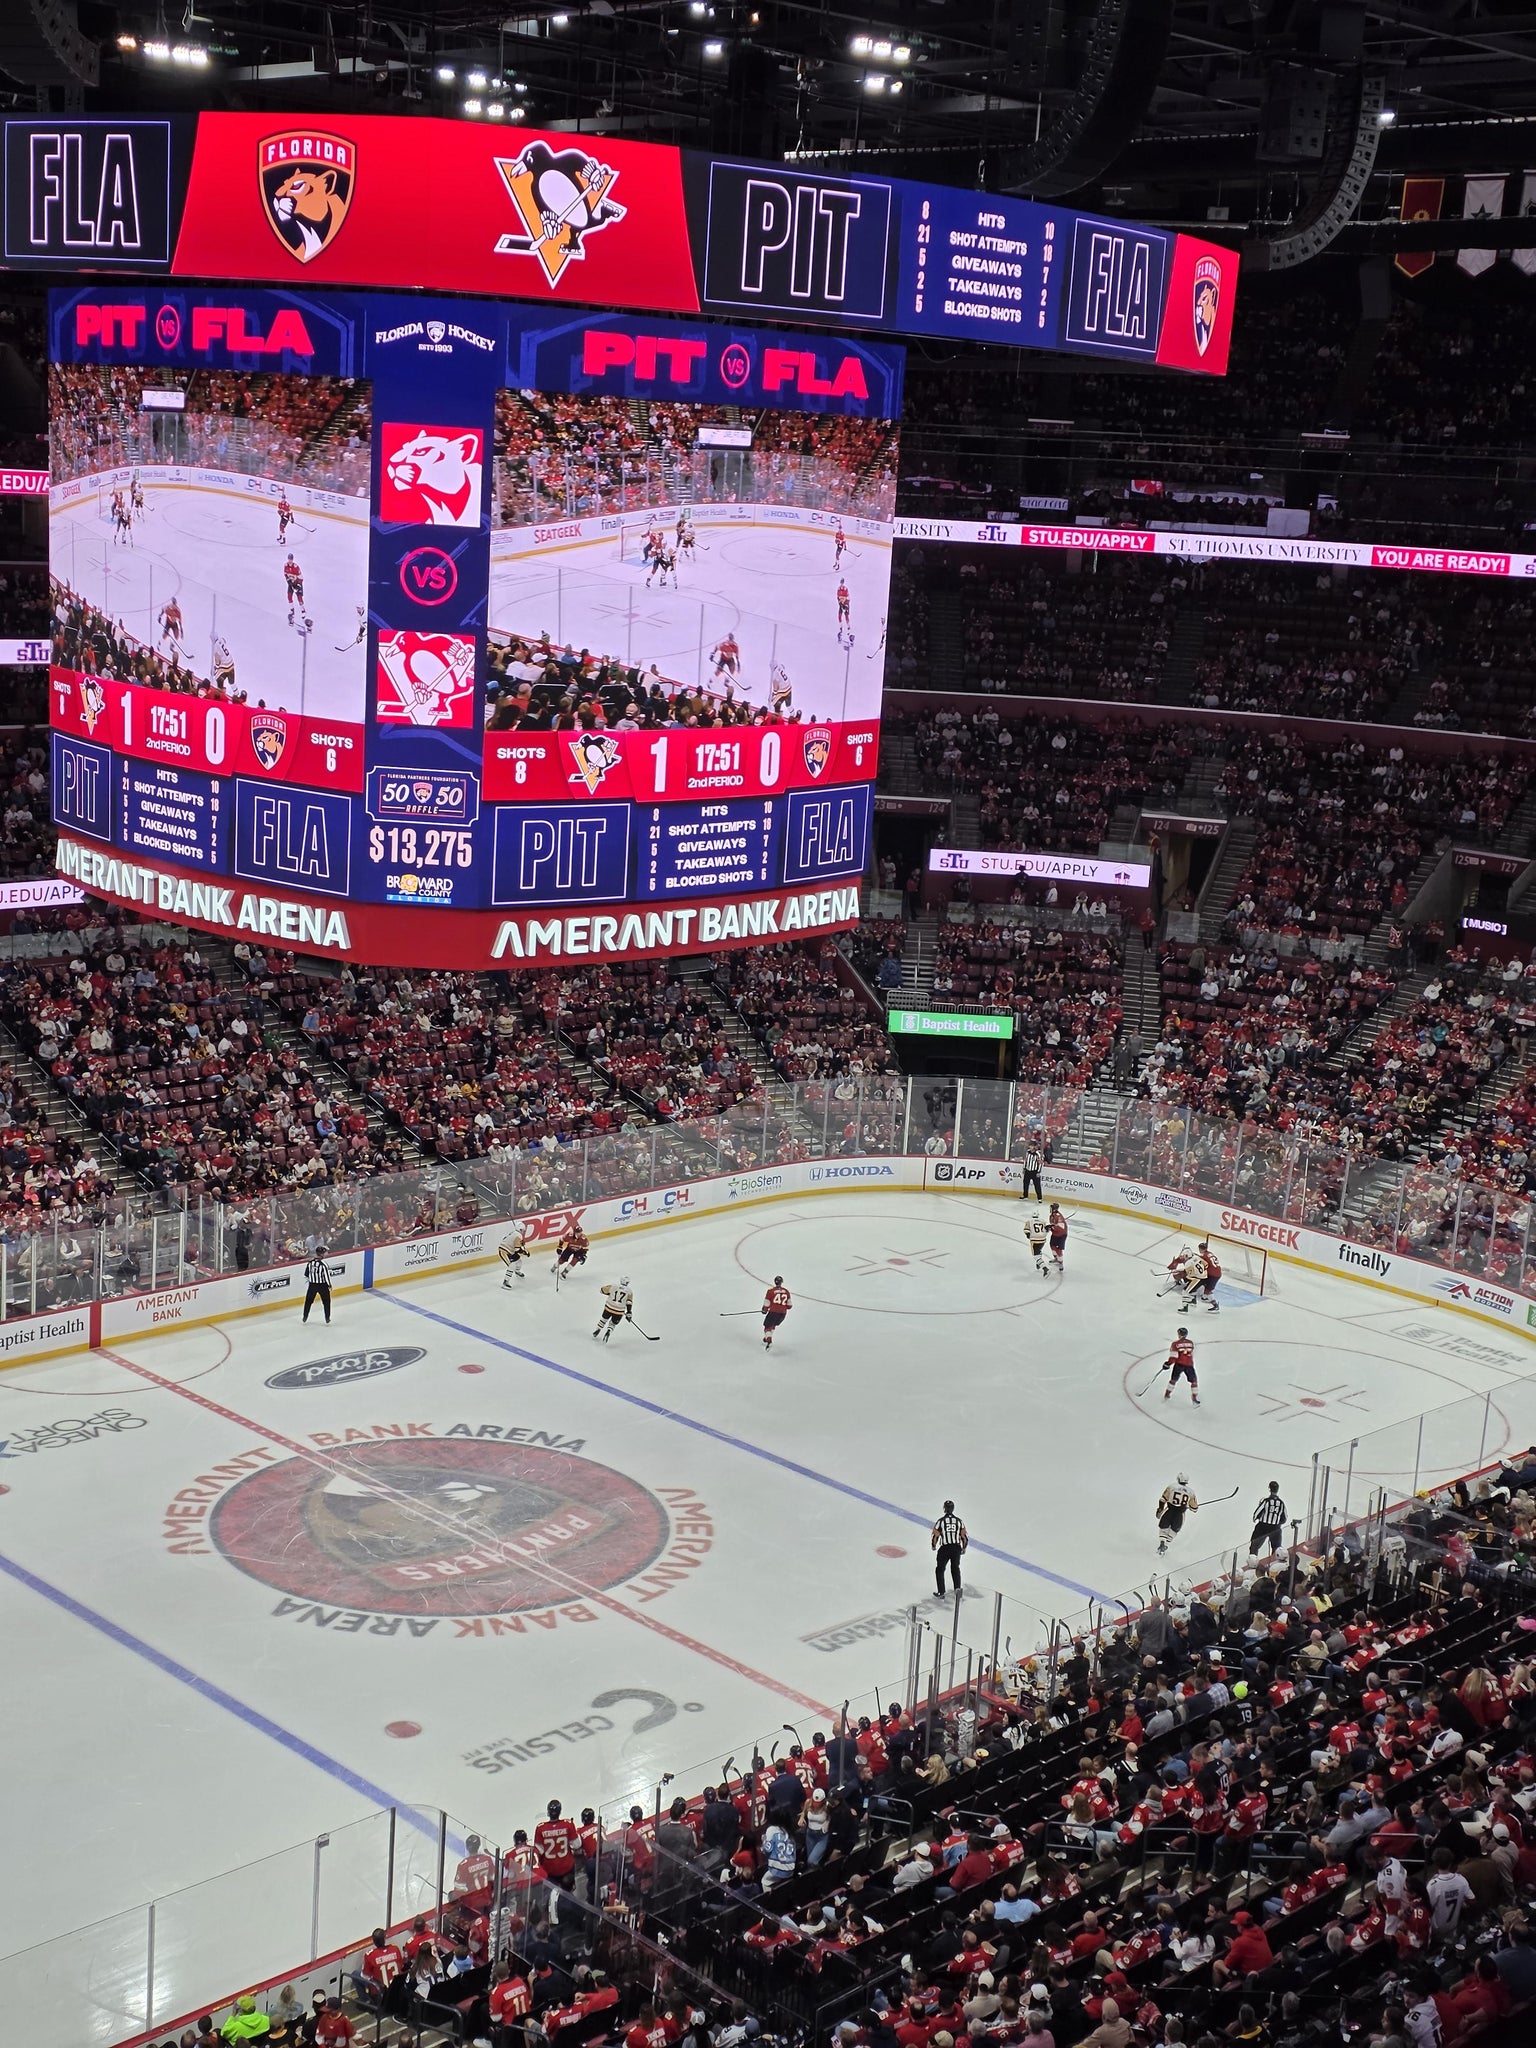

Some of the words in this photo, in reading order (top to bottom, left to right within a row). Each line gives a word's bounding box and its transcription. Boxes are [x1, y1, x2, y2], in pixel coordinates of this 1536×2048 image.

[266, 138, 347, 164] FLORIDA
[30, 133, 141, 248] FLA
[922, 200, 930, 220] 8
[978, 212, 1006, 230] HITS
[1045, 221, 1055, 241] 10
[741, 179, 861, 300] PIT
[917, 223, 931, 244] 21
[950, 230, 978, 249] SHOT
[978, 235, 1028, 257] ATTEMPTS
[918, 247, 927, 267] 5
[951, 254, 1022, 278] GIVEAWAYS
[1042, 266, 1050, 285] 7
[917, 271, 925, 290] 2
[948, 277, 1022, 301] TAKEAWAYS
[1084, 233, 1150, 340] FLA
[915, 294, 923, 313] 5
[944, 300, 990, 319] BLOCKED
[990, 306, 1022, 323] SHOTS
[75, 304, 146, 347] PIT
[160, 319, 176, 336] VS
[191, 307, 315, 355] FLA
[375, 321, 424, 345] FLORIDA
[447, 323, 496, 352] HOCKEY
[435, 343, 453, 353] 1993
[583, 330, 706, 382] PIT
[726, 358, 746, 377] VS
[761, 348, 869, 400] FLA
[205, 473, 235, 485] HONDA
[771, 510, 800, 520] HONDA
[534, 522, 583, 545] SEATGEEK
[977, 525, 1007, 542] STU
[1028, 528, 1148, 550] STU.EDU/APPLY
[1168, 537, 1192, 552] ST.
[1196, 539, 1264, 558] THOMAS
[1267, 543, 1362, 563] UNIVERSITY
[1376, 547, 1410, 566] YOU
[1411, 552, 1444, 569] ARE
[1447, 554, 1506, 573] READY!
[412, 566, 446, 590] VS
[17, 642, 49, 661] STU
[53, 680, 71, 695] SHOTS
[120, 690, 132, 746] 1
[150, 705, 187, 739] 17:51
[252, 717, 286, 731] FLORIDA
[146, 737, 161, 750] 2nd
[160, 740, 191, 756] PERIOD
[205, 707, 225, 765] 0
[310, 732, 354, 749] SHOTS
[847, 733, 873, 745] SHOTS
[326, 749, 337, 772] 6
[497, 747, 546, 760] SHOTS
[650, 736, 668, 793] 1
[695, 742, 741, 772] 17:51
[759, 731, 781, 787] 0
[855, 745, 862, 767] 6
[156, 769, 178, 784] HITS
[210, 780, 220, 794] 10
[514, 761, 527, 784] 8
[688, 777, 708, 788] 2nd
[707, 775, 744, 788] PERIOD
[62, 749, 100, 822] PIT
[134, 780, 156, 796] SHOT
[156, 786, 204, 807] ATTEMPTS
[382, 782, 410, 803] 50
[435, 786, 463, 806] 50
[140, 799, 196, 823] GIVEAWAYS
[405, 804, 439, 815] RAFFLE
[652, 808, 660, 822] 8
[701, 805, 729, 817] HITS
[764, 800, 773, 814] 10
[138, 816, 197, 840] TAKEAWAYS
[253, 796, 330, 878] FLA
[649, 825, 661, 839] 21
[668, 824, 700, 837] SHOT
[700, 820, 757, 834] ATTEMPTS
[799, 799, 854, 868] FLA
[1153, 821, 1169, 831] 124
[1202, 824, 1219, 835] 125
[133, 832, 171, 851] BLOCKED
[172, 842, 204, 860] SHOTS
[369, 825, 473, 869] $13,275
[520, 818, 606, 890] PIT
[677, 837, 747, 853] GIVEAWAYS
[674, 854, 748, 870] TAKEAWAYS
[939, 853, 969, 870] STU
[980, 857, 1099, 878] STU.EDU/APPLY
[1455, 854, 1470, 866] 125
[1501, 861, 1518, 873] 127
[665, 874, 717, 889] BLOCKED
[718, 870, 754, 884] SHOTS
[55, 838, 159, 900] AMERANT
[159, 873, 235, 926] BANK
[237, 893, 352, 950] ARENA
[418, 889, 452, 898] COUNTY
[490, 908, 698, 960] AMERANT
[698, 899, 781, 943] BANK
[781, 885, 861, 931] ARENA
[922, 1017, 960, 1032] Baptist
[963, 1020, 1000, 1033] Health
[740, 1174, 783, 1191] BioStem
[825, 1164, 894, 1178] HONDA
[1008, 1171, 1022, 1179] ABA
[1066, 1178, 1095, 1189] FLORIDA
[1120, 1187, 1134, 1197] Hard
[1135, 1190, 1150, 1201] Rock
[621, 1196, 647, 1215] CH
[664, 1187, 689, 1206] CH
[1033, 1223, 1044, 1233] 67
[1220, 1211, 1301, 1251] SEATGEEK
[414, 1241, 439, 1258] JOINT
[450, 1245, 484, 1257] chiropractic
[459, 1232, 484, 1249] JOINT
[404, 1254, 439, 1267] chiropractic
[1339, 1243, 1392, 1277] finally
[136, 1288, 200, 1312] AMERANT
[613, 1290, 627, 1303] 17
[773, 1293, 788, 1306] 42
[1474, 1296, 1511, 1314] ROOFING
[1475, 1287, 1514, 1307] ACTION
[152, 1306, 182, 1322] BANK
[39, 1318, 84, 1340] Health
[1437, 1342, 1509, 1366] Health
[1453, 1337, 1528, 1362] Baptist
[297, 1351, 392, 1381] Ford
[10, 1407, 133, 1444] SPORT
[12, 1416, 148, 1454] OMEGA
[163, 1446, 281, 1557] AMERANT
[308, 1421, 436, 1447] BANK
[444, 1422, 588, 1453] ARENA
[1172, 1491, 1189, 1506] 58
[945, 1523, 957, 1533] 29
[398, 1510, 595, 1583] PANTHERS
[638, 1487, 716, 1605] AMERANT
[270, 1596, 441, 1640] ARENA
[453, 1602, 601, 1639] BANK
[1240, 1709, 1253, 1723] 19
[471, 1714, 616, 1775] CELSIUS
[542, 1836, 569, 1859] 23
[1413, 1908, 1424, 1920] 19
[1445, 1898, 1458, 1923] 7
[1131, 1937, 1144, 1950] 16
[379, 1961, 400, 1988] 13
[511, 1994, 528, 2016] 11
